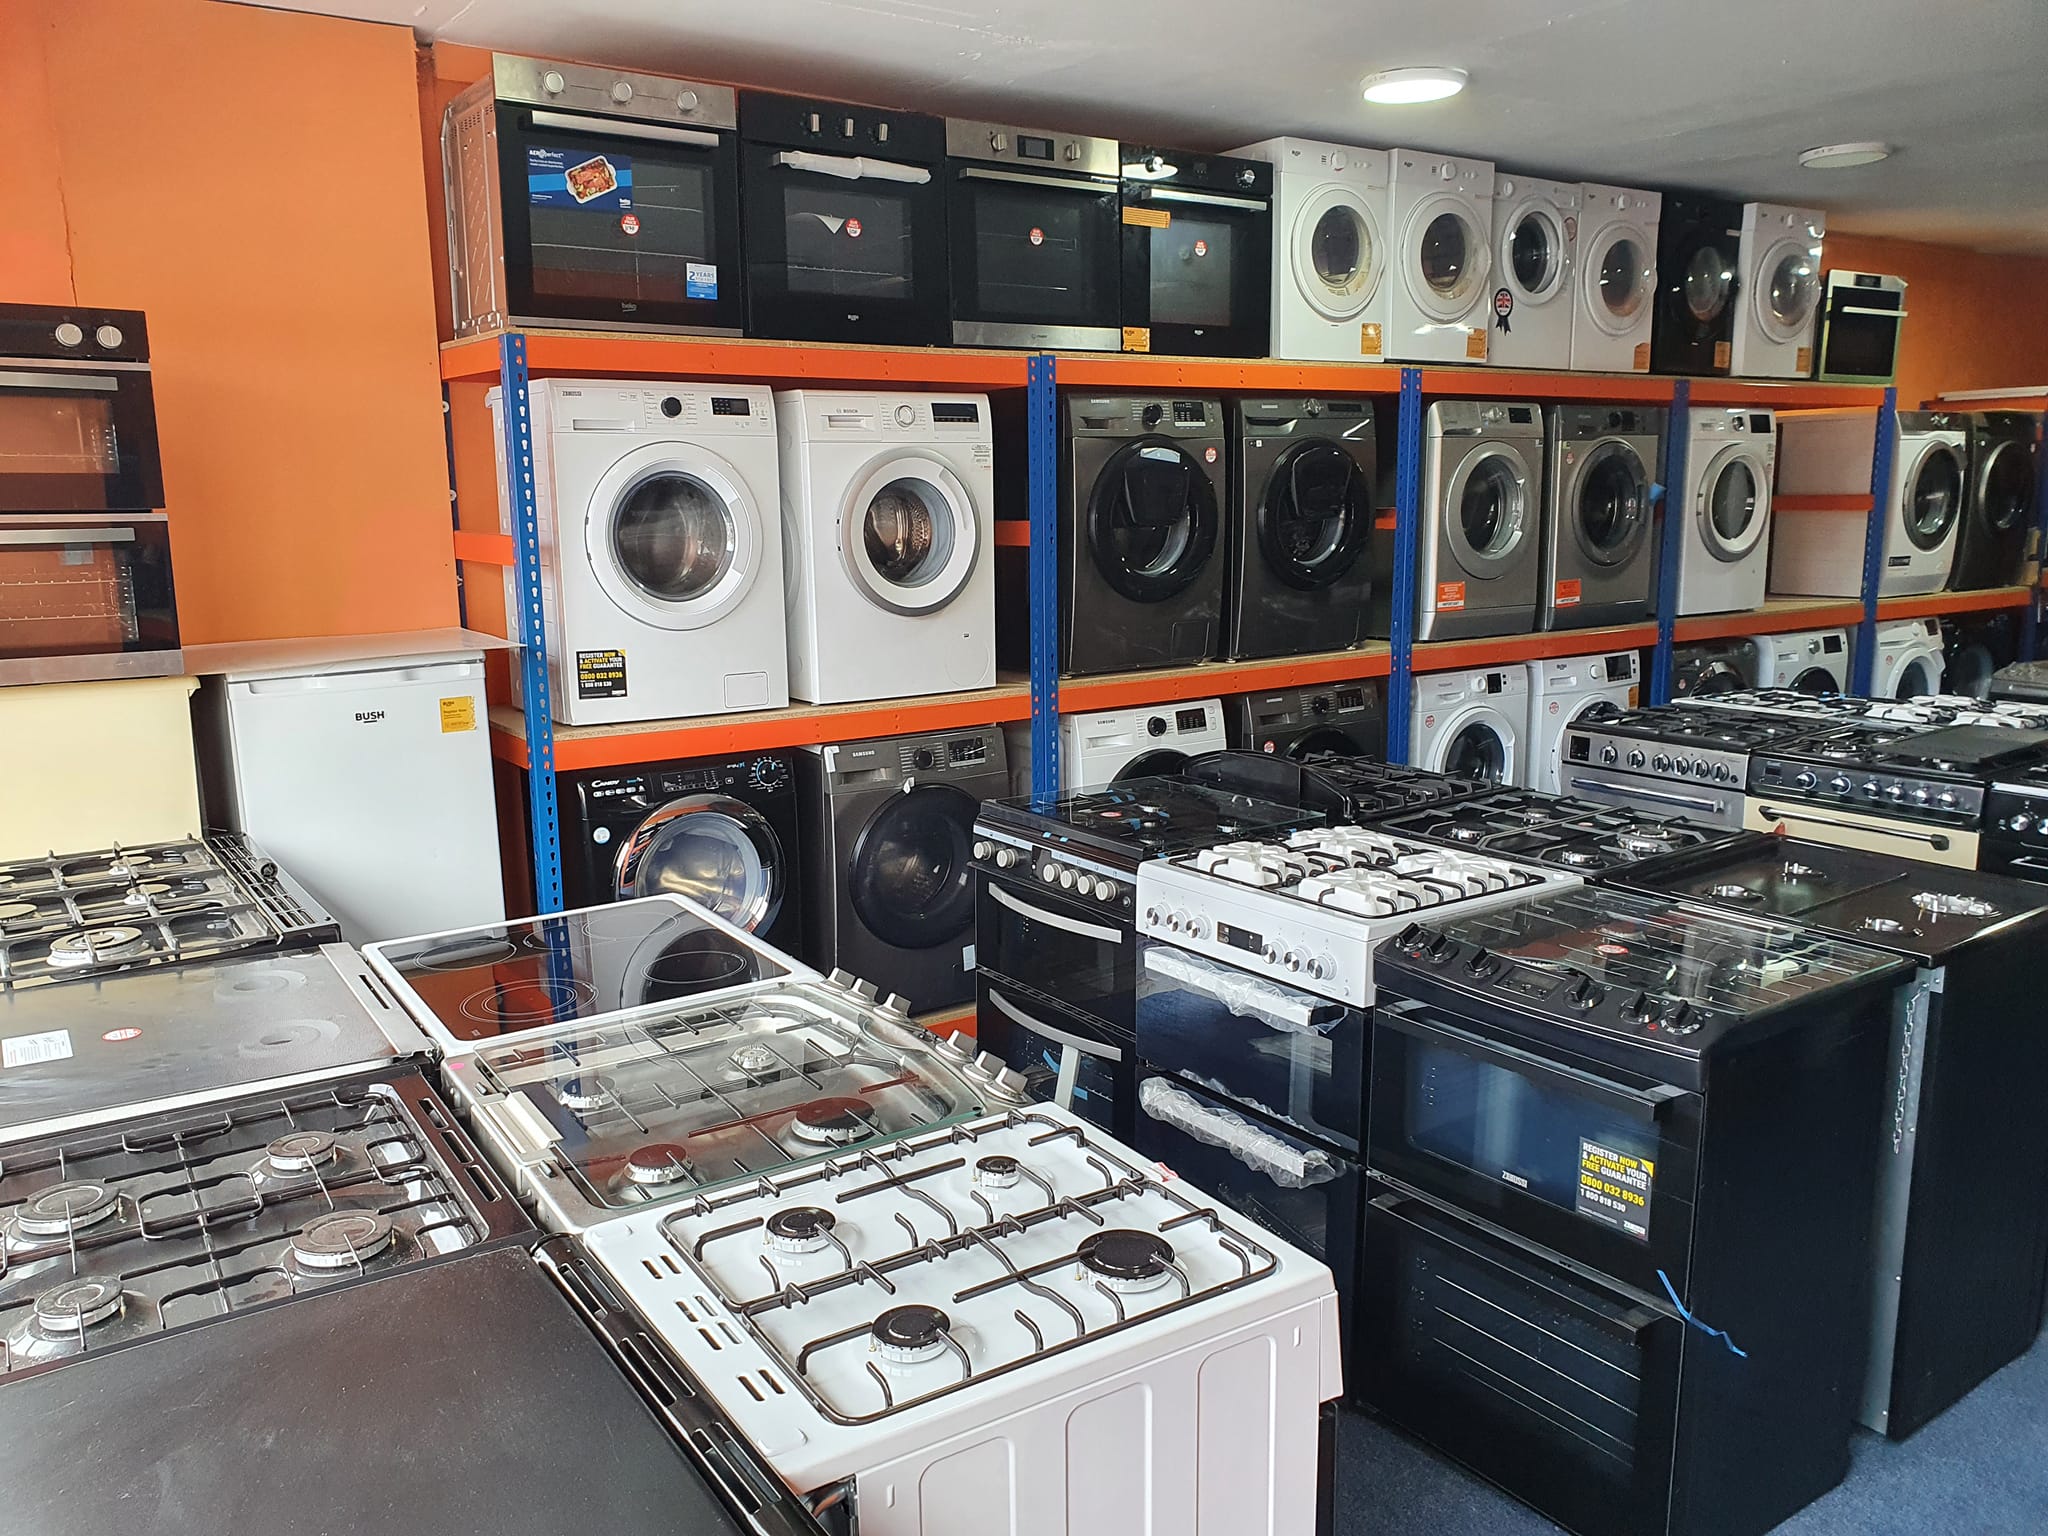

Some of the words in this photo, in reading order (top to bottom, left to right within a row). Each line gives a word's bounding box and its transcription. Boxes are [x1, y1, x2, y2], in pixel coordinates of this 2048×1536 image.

[689, 271, 696, 280] 2
[355, 711, 385, 723] BUSH
[1582, 1142, 1618, 1162] REGISTER
[1620, 1156, 1638, 1168] NOW
[1583, 1151, 1588, 1159] &
[1589, 1154, 1625, 1173] ACTIVATE
[1626, 1166, 1648, 1182] YOUR
[1582, 1159, 1600, 1173] FREE
[1600, 1166, 1646, 1190] GUARANTEE
[1581, 1174, 1602, 1190] 0800
[1604, 1183, 1620, 1196] 032
[1622, 1190, 1645, 1206] 8936
[1585, 1191, 1598, 1201] 800
[1600, 1196, 1612, 1206] 818
[1612, 1201, 1626, 1213] 530
